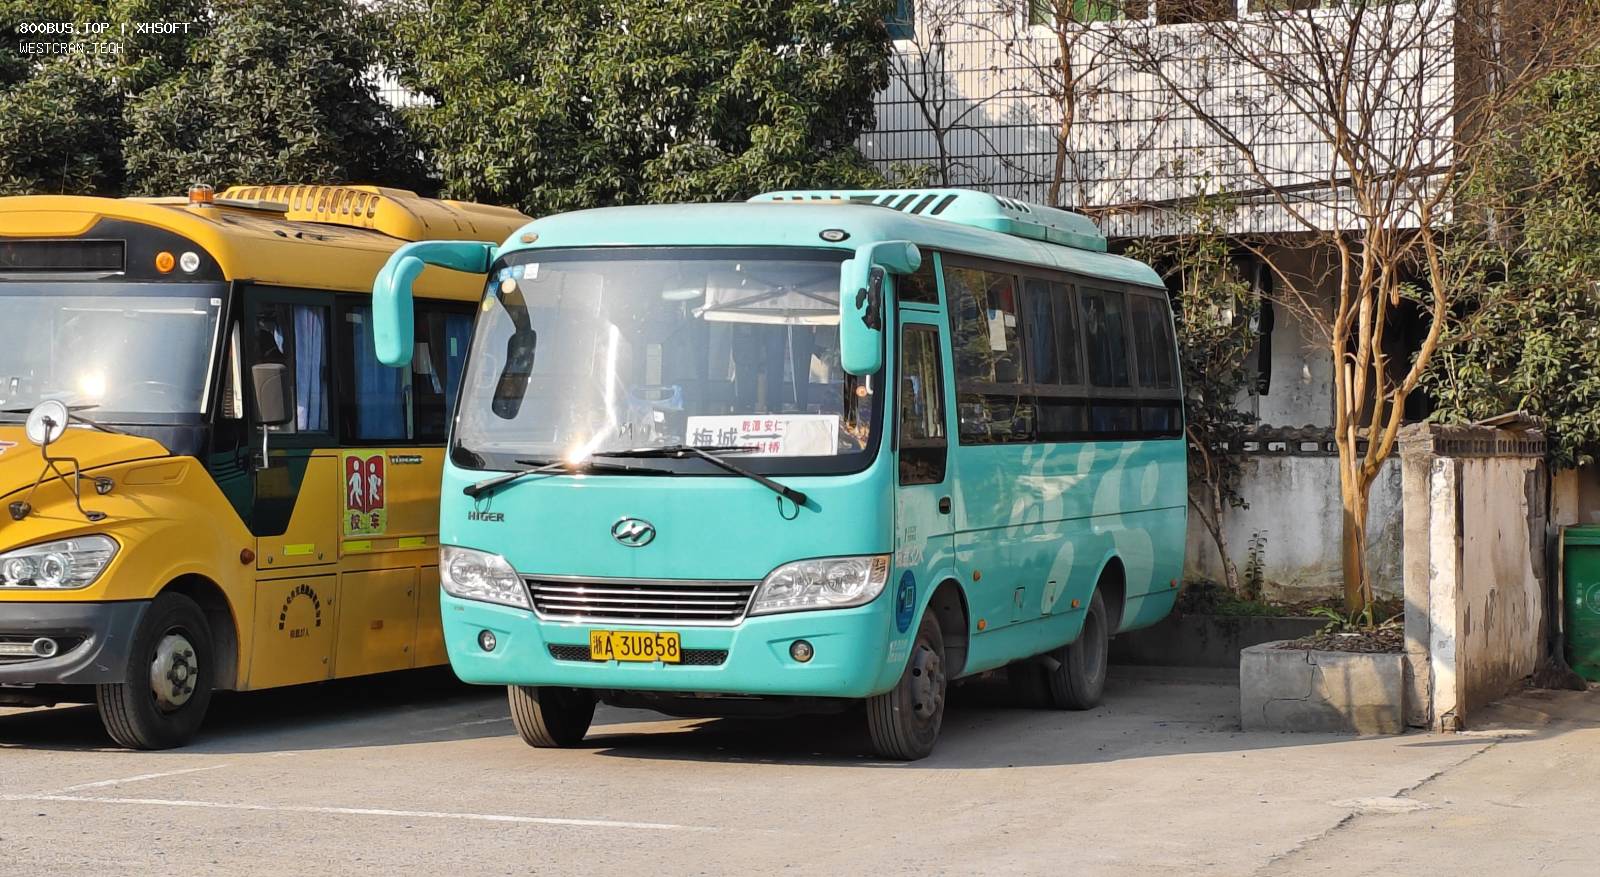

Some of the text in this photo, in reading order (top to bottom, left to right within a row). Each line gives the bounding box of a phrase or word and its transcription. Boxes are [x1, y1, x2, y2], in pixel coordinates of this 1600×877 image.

[764, 420, 784, 432] 安仁
[692, 427, 738, 447] 梅城
[351, 513, 380, 530] 校车
[467, 511, 505, 522] HIGER
